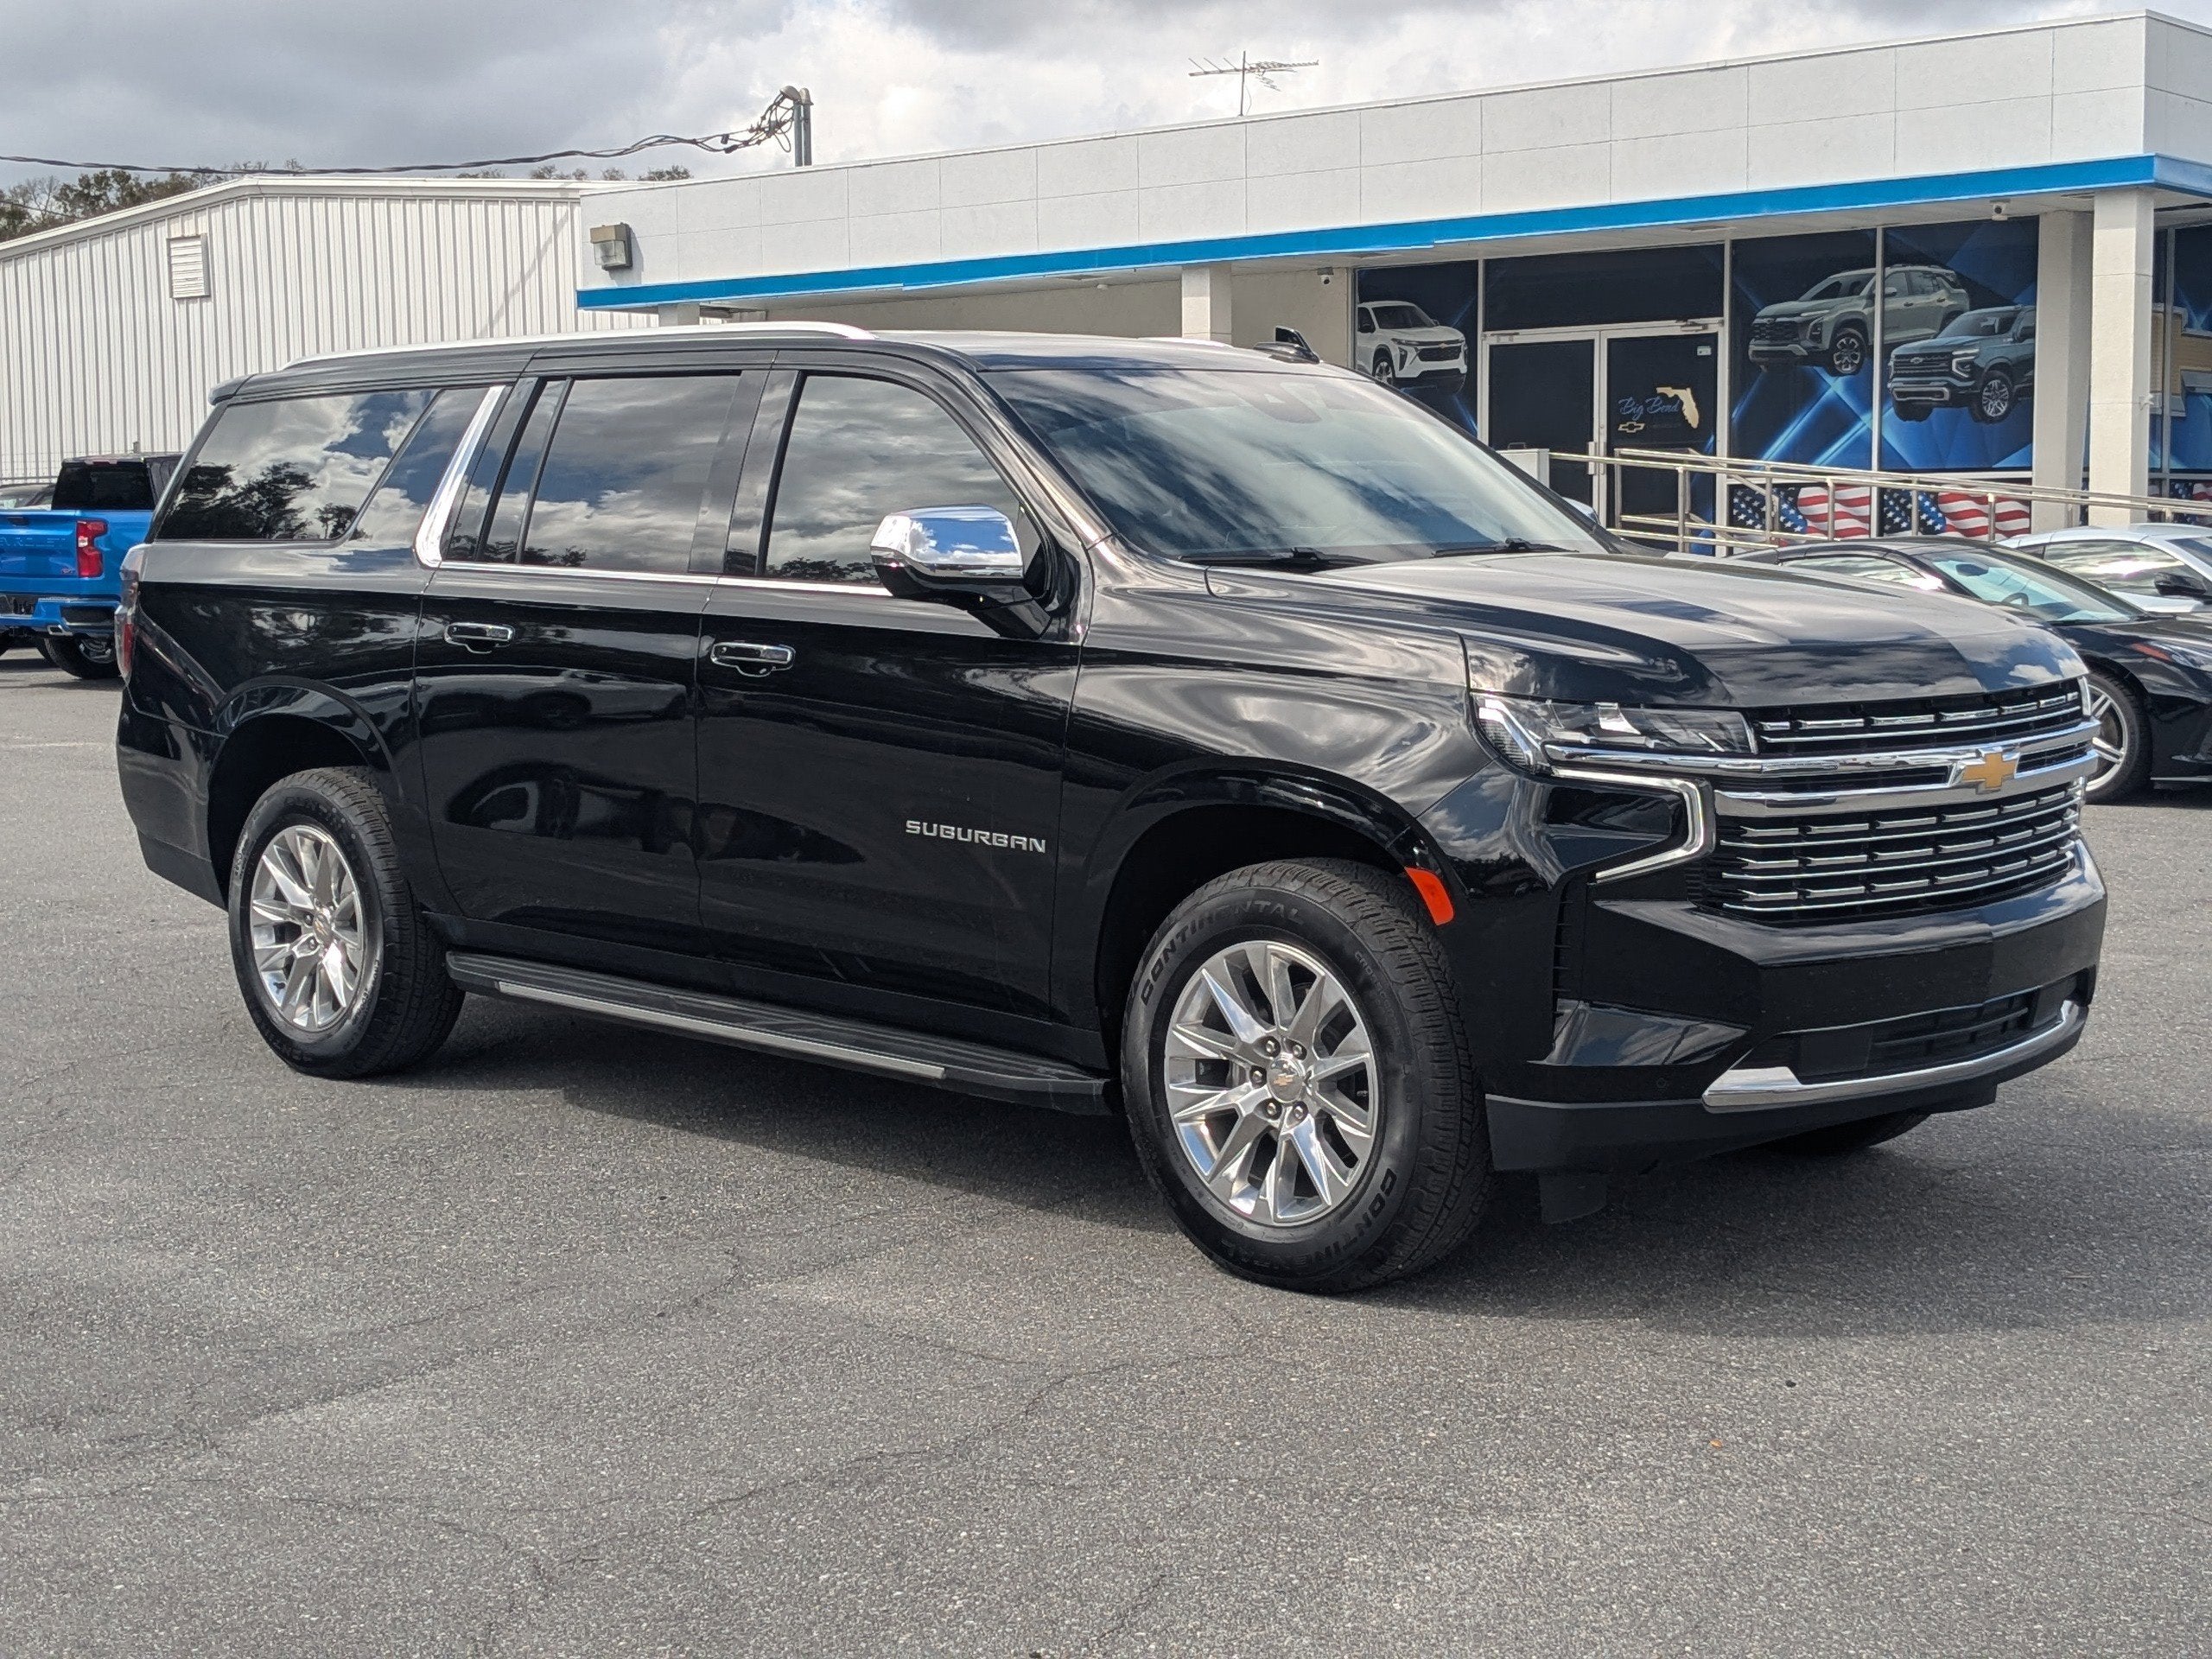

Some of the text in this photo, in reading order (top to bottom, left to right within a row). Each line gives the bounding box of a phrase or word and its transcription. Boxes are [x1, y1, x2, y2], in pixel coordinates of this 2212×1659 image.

[1618, 396, 1681, 421] Big Bend
[906, 820, 1046, 854] SUBURBAN
